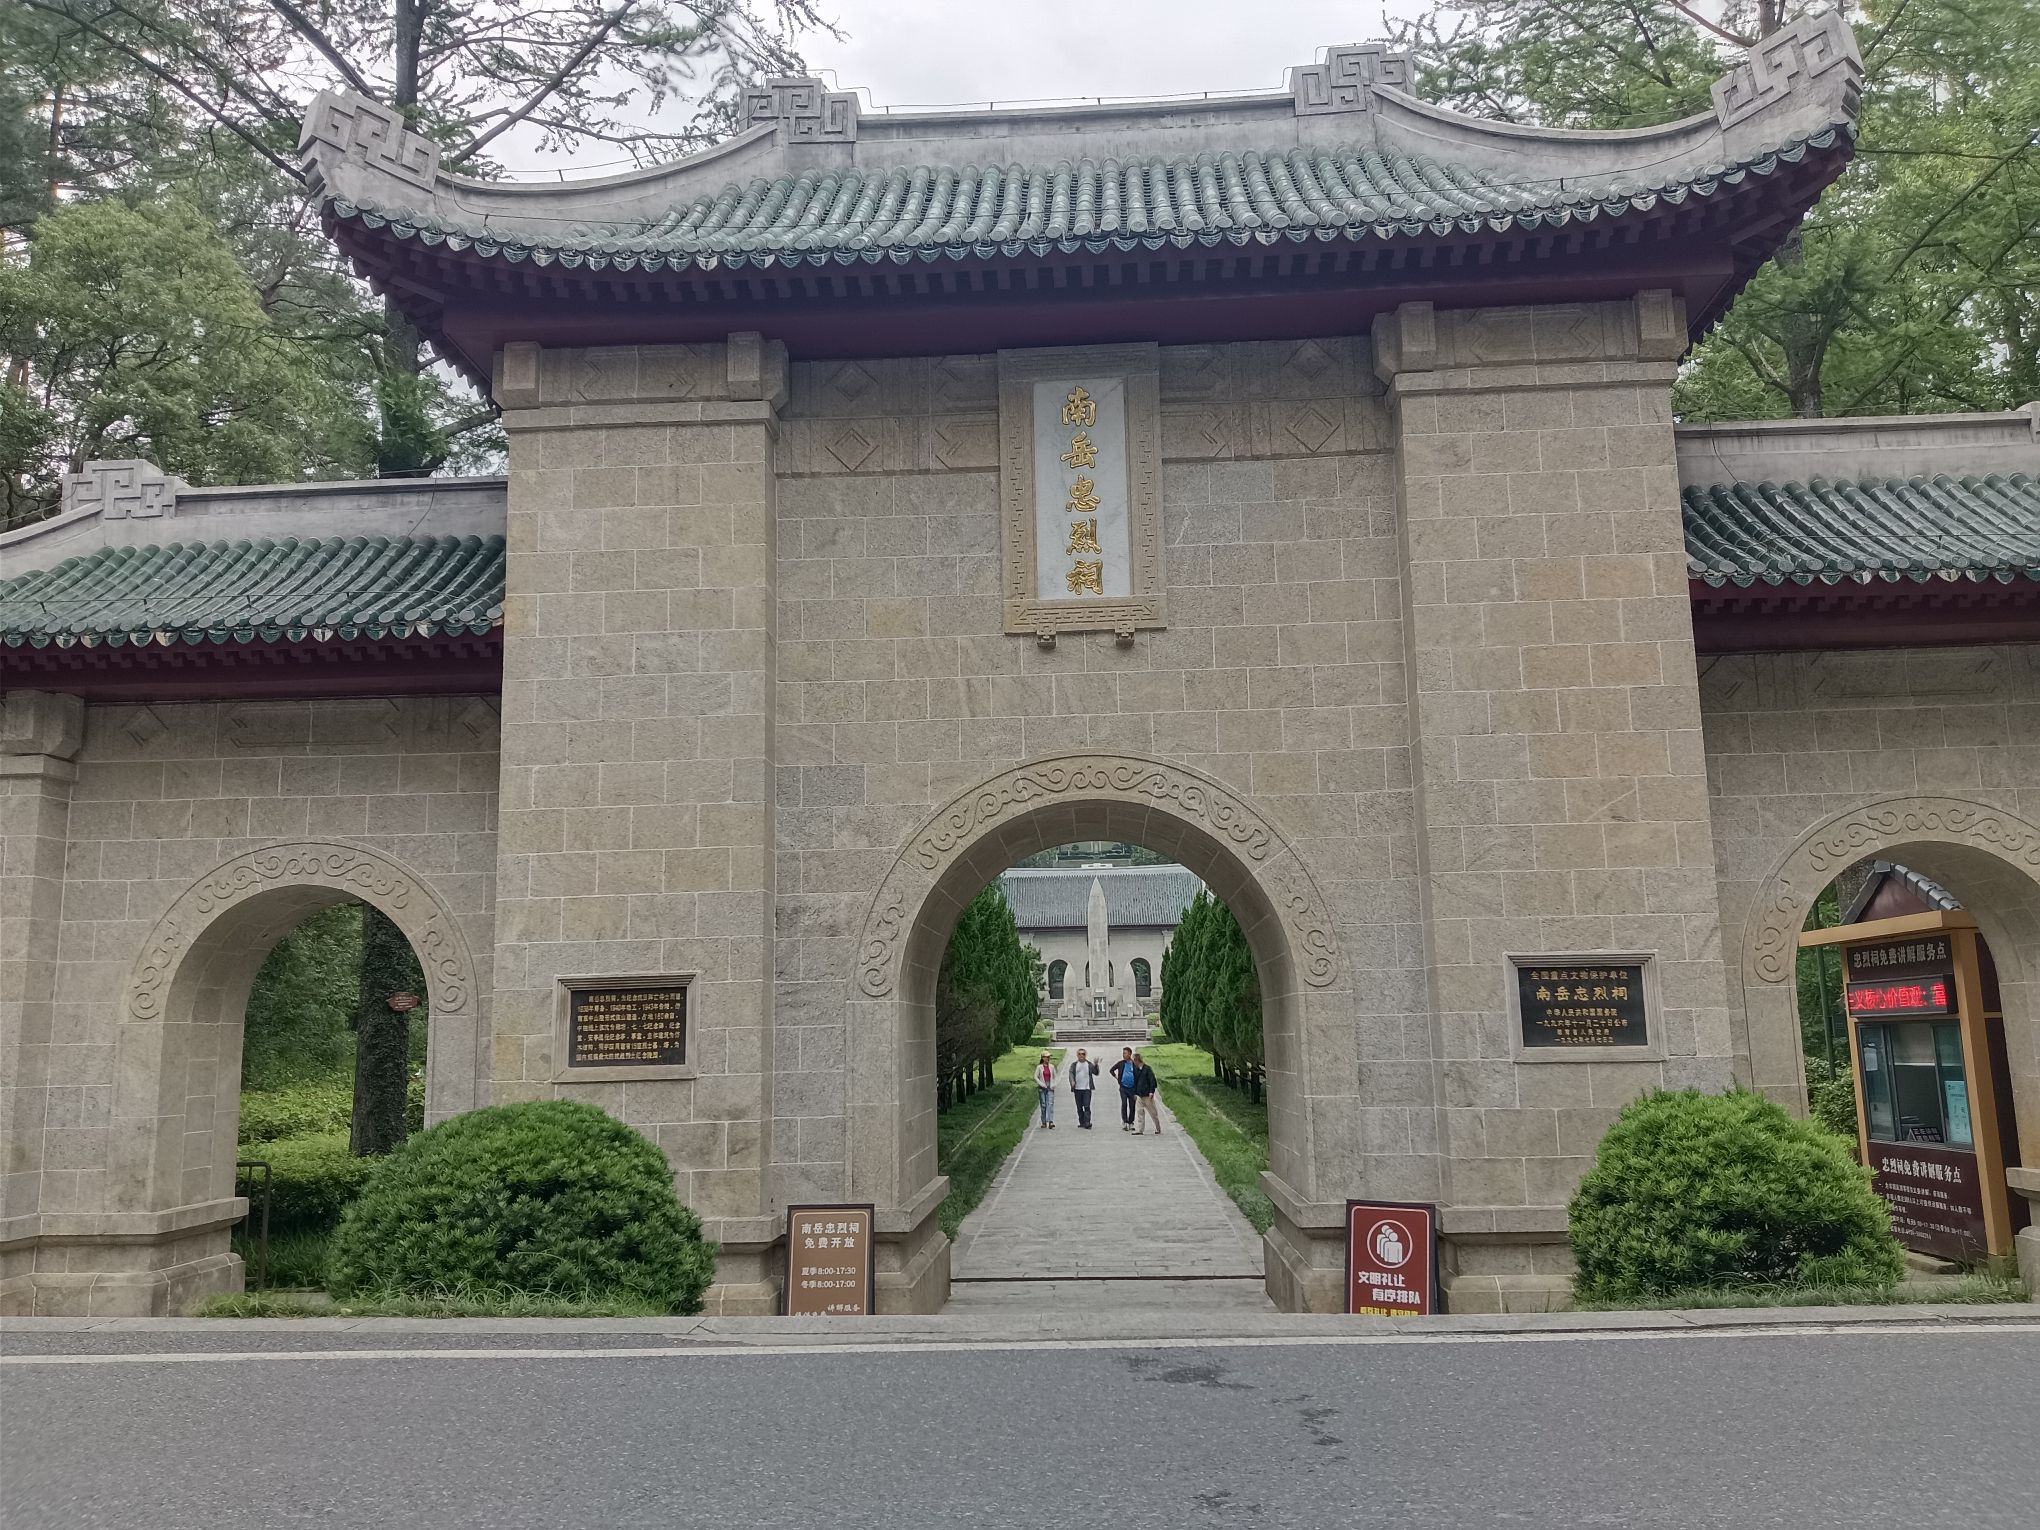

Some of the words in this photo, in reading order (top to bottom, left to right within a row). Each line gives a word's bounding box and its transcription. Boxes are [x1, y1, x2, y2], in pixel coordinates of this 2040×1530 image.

[1060, 386, 1104, 595] 南岳忠烈祠
[1853, 941, 1947, 969] 忠烈祠免费讲解服务点
[1530, 970, 1629, 981] 全国重点文物保护单位
[1535, 985, 1629, 1001] 南岳忠烈祠
[1881, 1156, 1962, 1184] 忠烈祠免费讲解服务点
[801, 1222, 860, 1235] 南岳忠烈祠
[804, 1237, 855, 1249] 免费开放
[1358, 1271, 1406, 1288] 文明礼让
[1372, 1288, 1421, 1305] 有序排队
